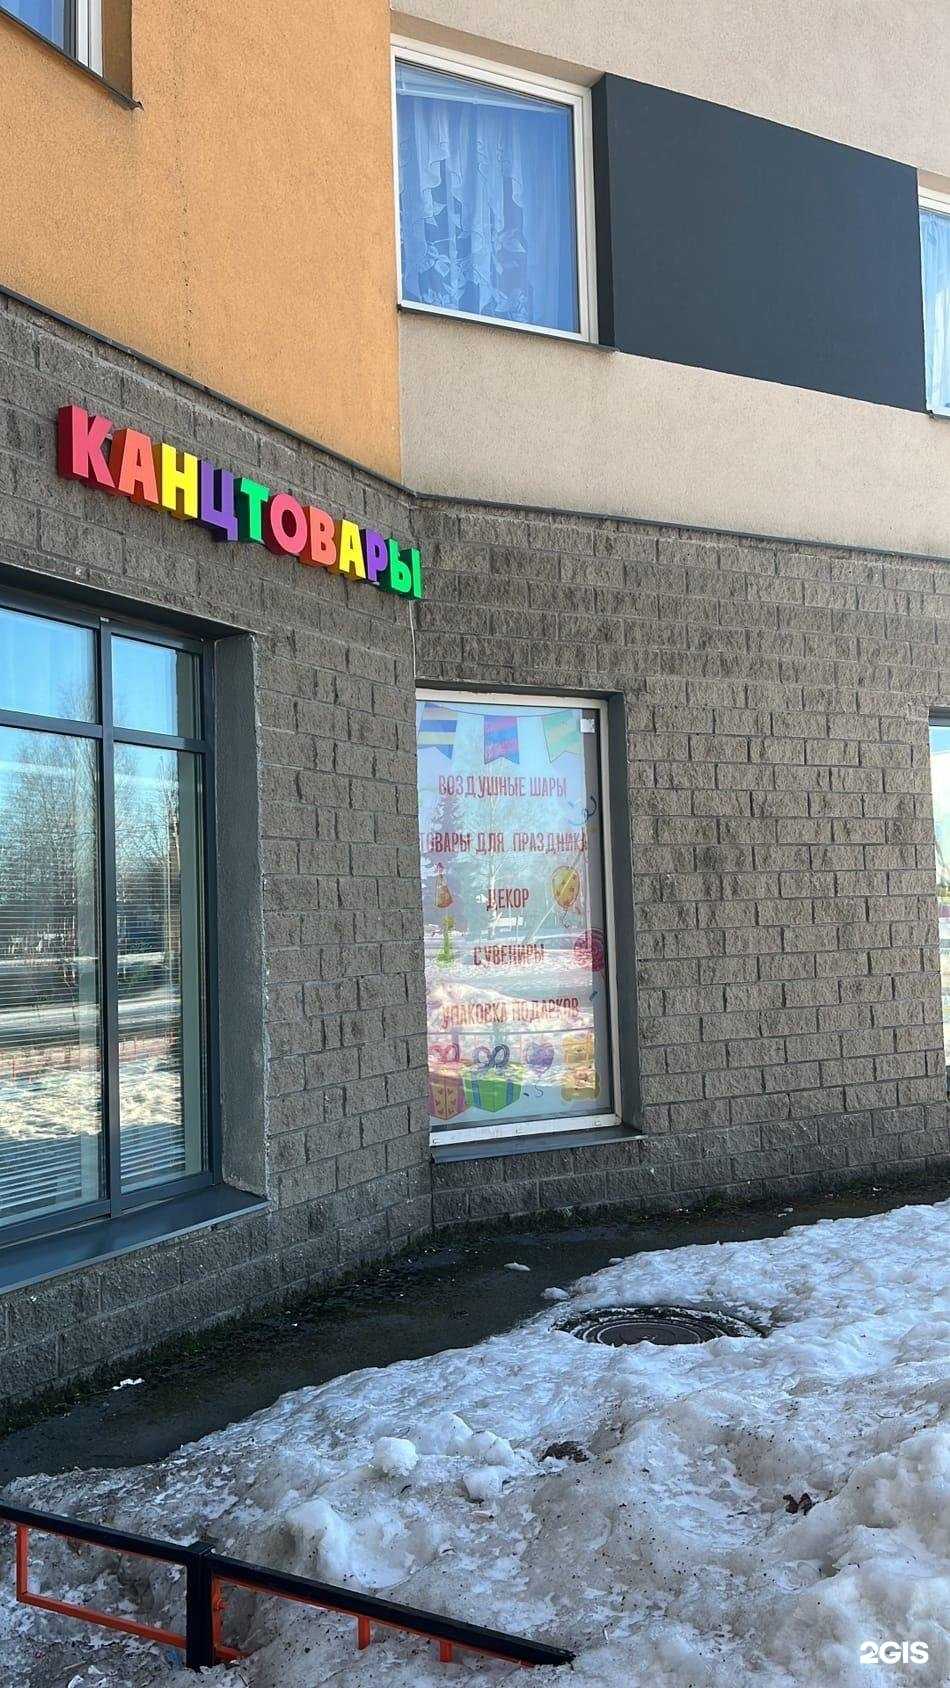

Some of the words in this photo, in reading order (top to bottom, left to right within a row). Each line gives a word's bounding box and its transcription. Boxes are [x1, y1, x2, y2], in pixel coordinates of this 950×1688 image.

[58, 404, 422, 600] КАНЦТОВАРЫ
[438, 775, 525, 799] ВОЗДУШНЫЕ
[530, 776, 567, 797] ШАРЫ
[475, 832, 504, 853] ДЛЯ
[486, 888, 529, 910] ДЕКОР
[473, 943, 545, 966] СУВЕНИРЫ
